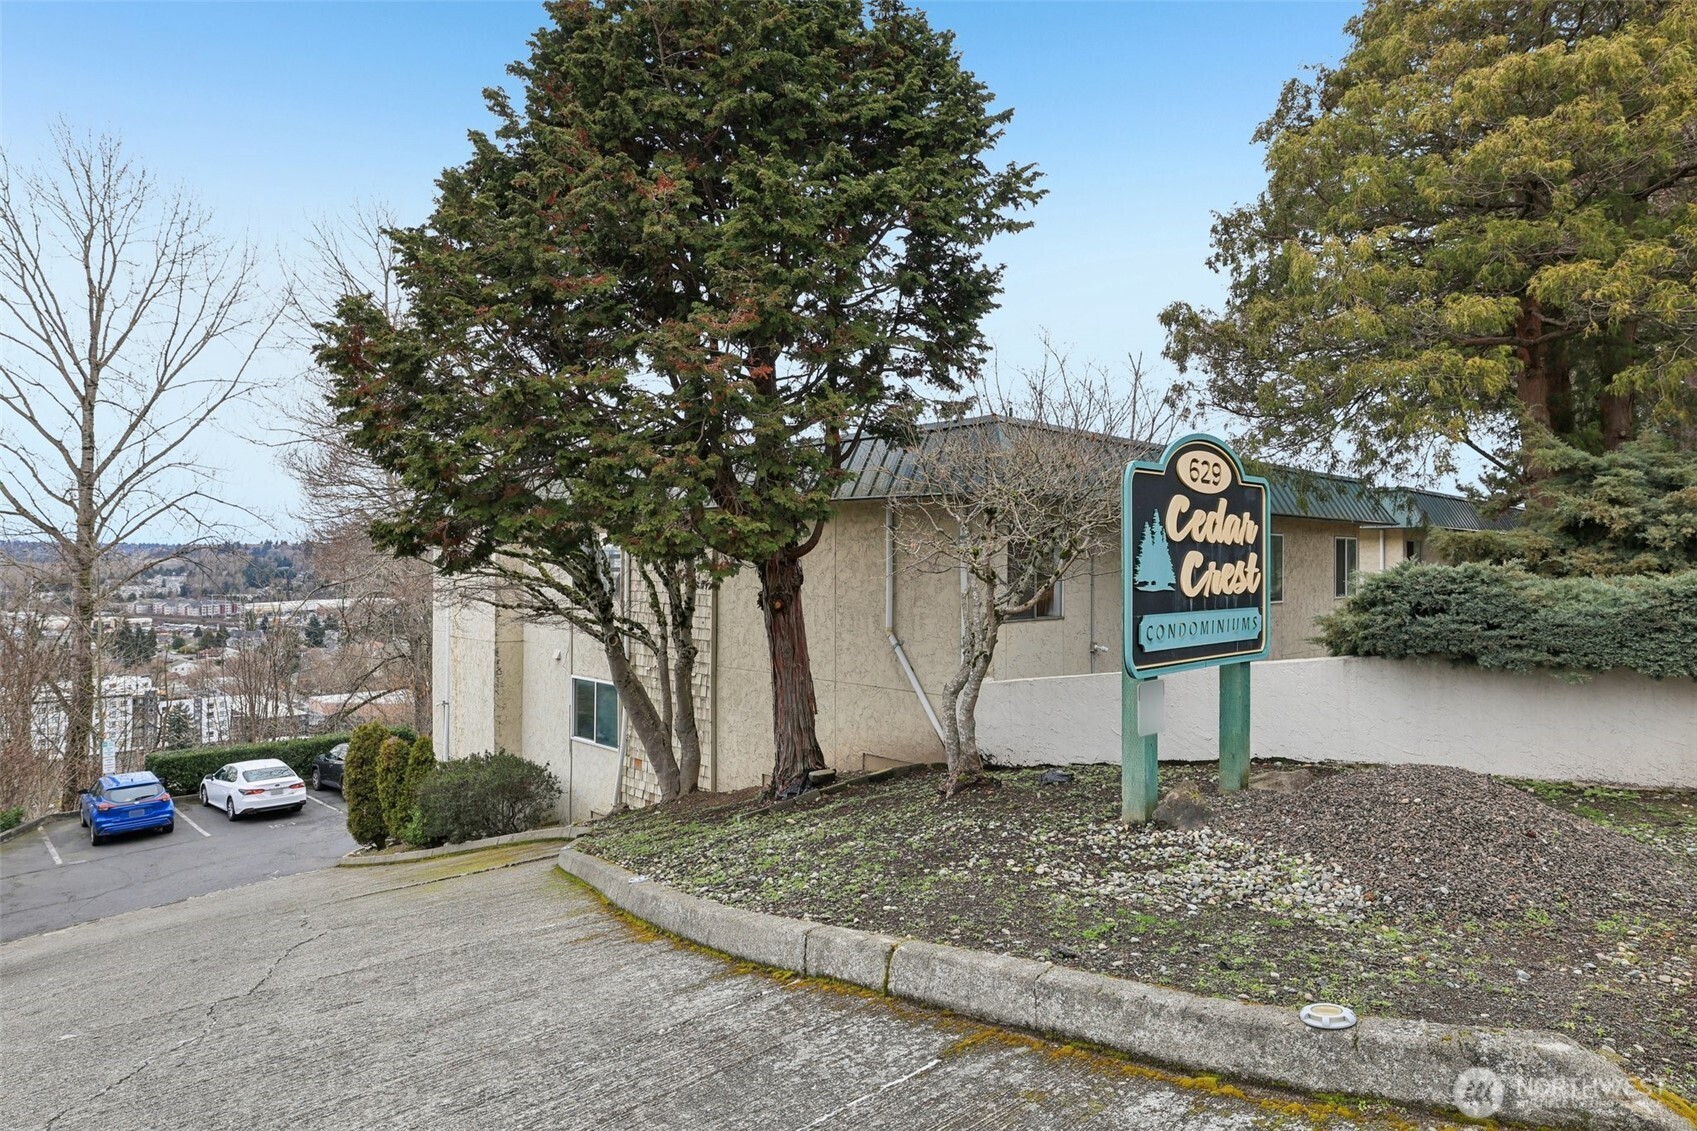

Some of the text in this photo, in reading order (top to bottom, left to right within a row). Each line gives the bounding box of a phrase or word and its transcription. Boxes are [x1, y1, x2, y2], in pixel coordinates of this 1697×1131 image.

[1189, 458, 1223, 487] 629
[1165, 494, 1259, 546] Cedar
[1180, 550, 1261, 598] Crest
[1145, 616, 1259, 642] CONDOMINIUMS
